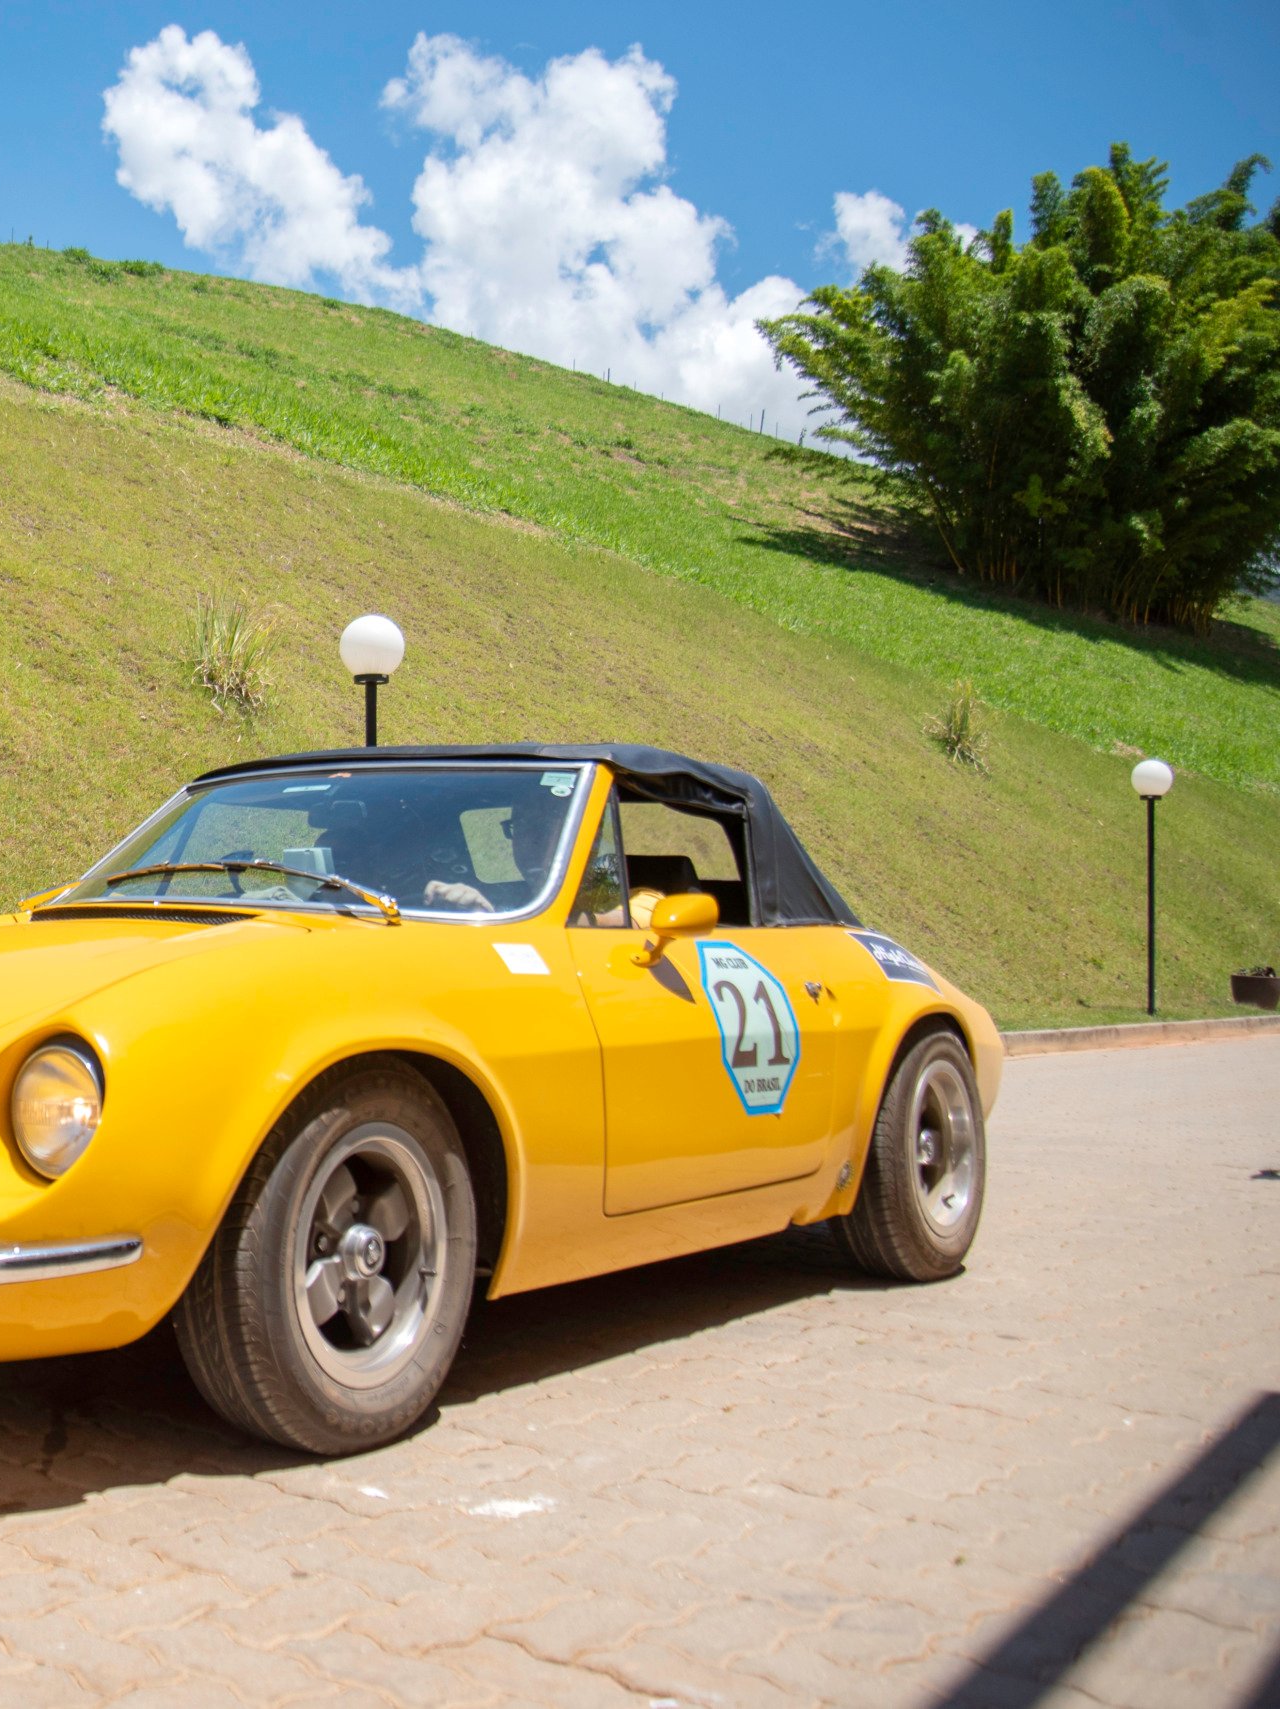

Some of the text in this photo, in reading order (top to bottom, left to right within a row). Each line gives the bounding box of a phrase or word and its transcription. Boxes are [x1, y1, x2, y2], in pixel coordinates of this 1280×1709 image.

[712, 957, 749, 969] MG CLUB
[713, 980, 790, 1069] 21
[744, 1077, 781, 1094] DO BRASIL
